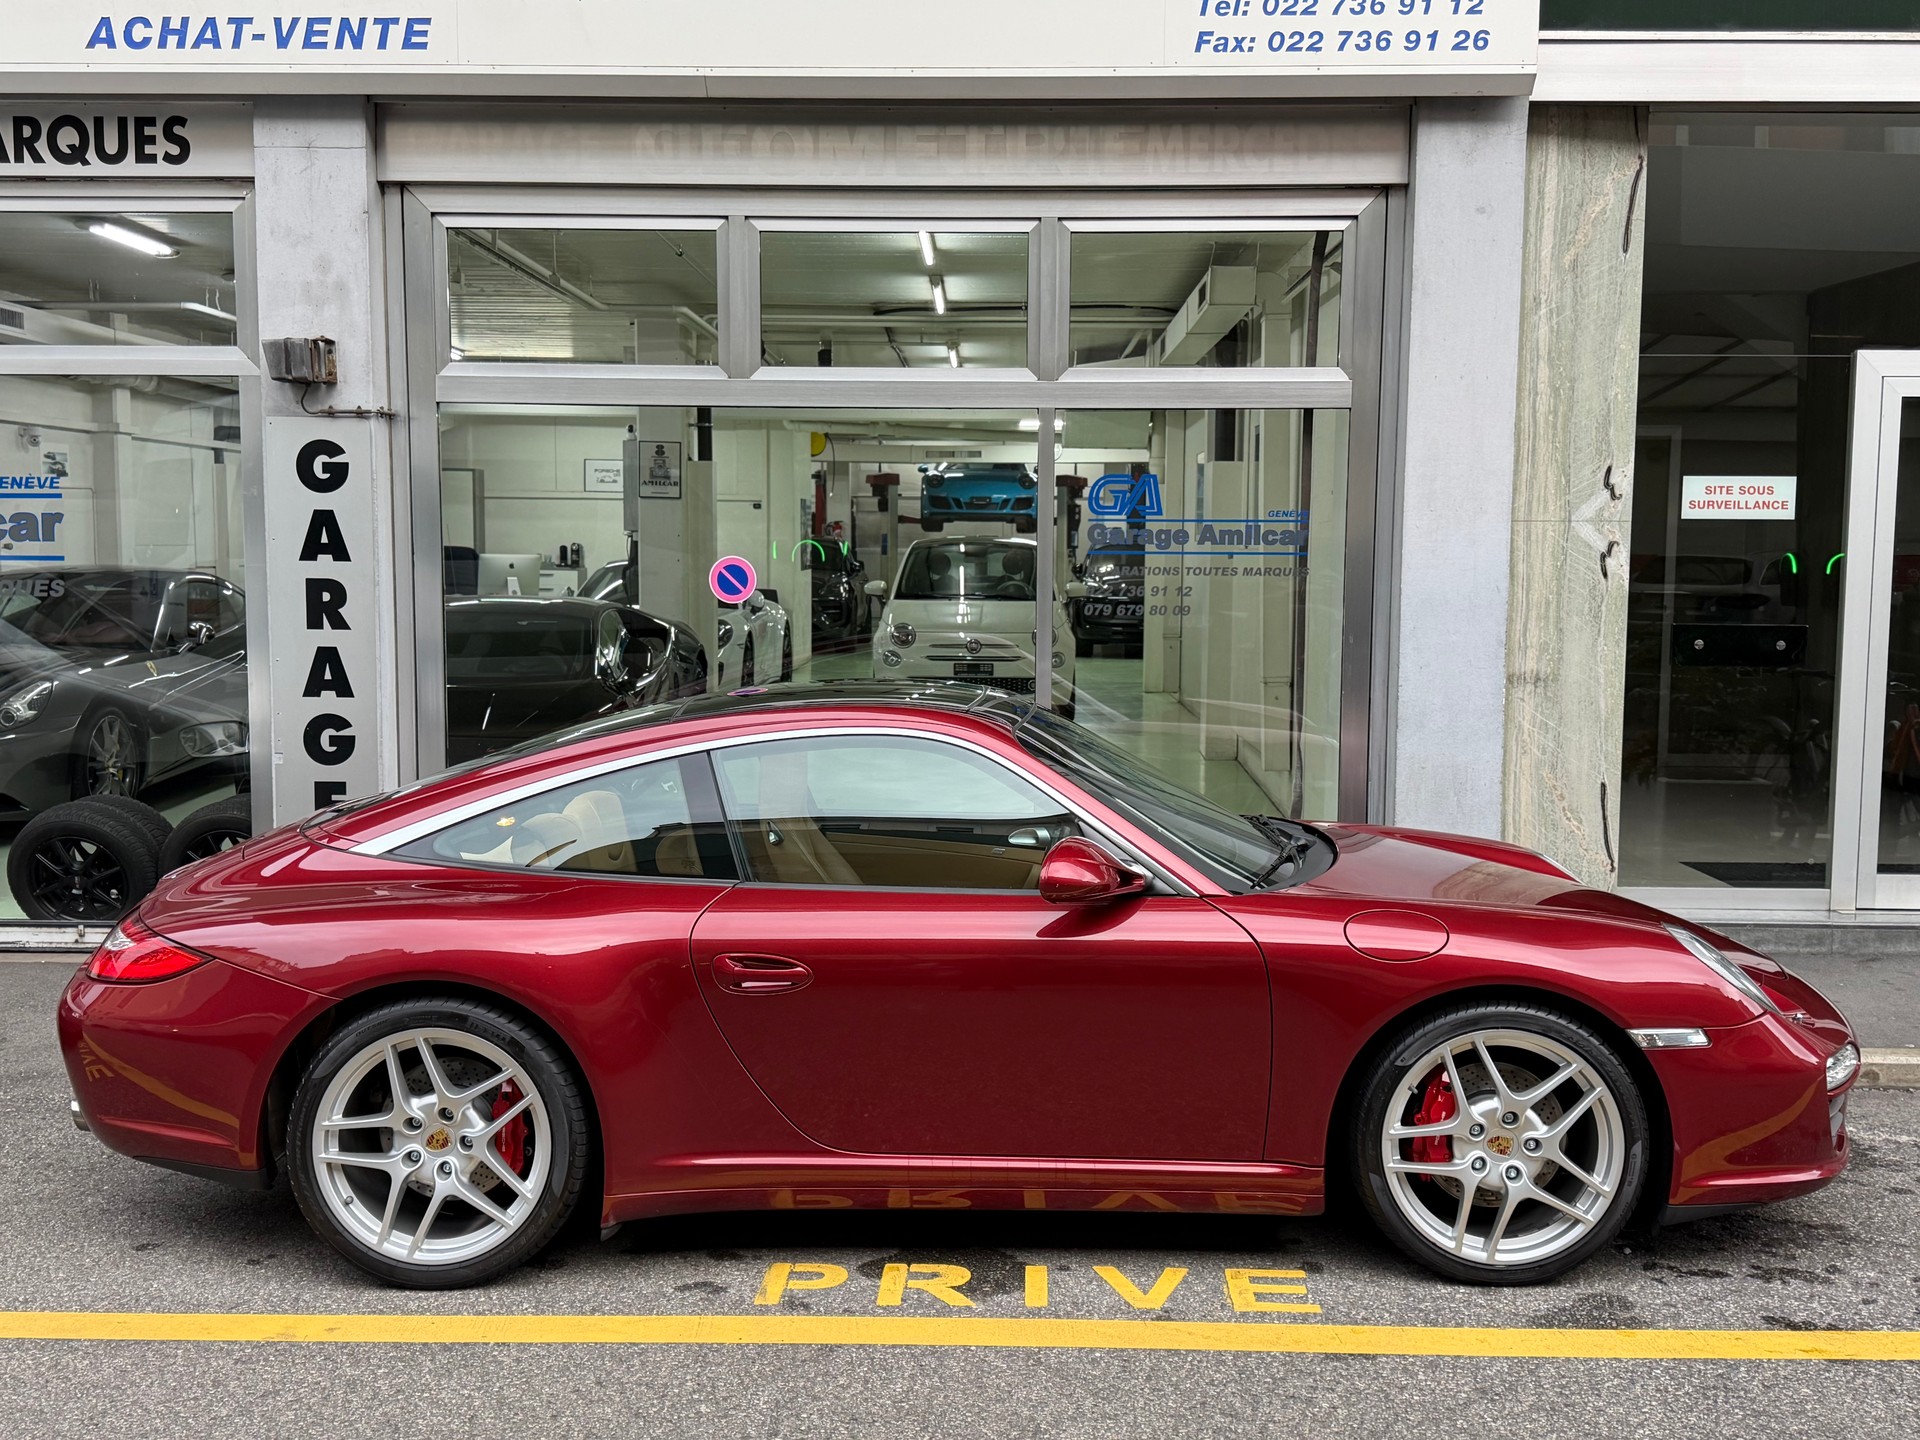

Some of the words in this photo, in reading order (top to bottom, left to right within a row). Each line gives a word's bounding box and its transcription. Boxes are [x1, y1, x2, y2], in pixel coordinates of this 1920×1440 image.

[1262, 0, 1318, 16] 022
[1332, 0, 1386, 16] 736
[1397, 0, 1432, 16] 91
[1451, 0, 1484, 16] 12
[84, 16, 432, 50] ACHAT-VENTE
[1194, 31, 1256, 53] Fax:
[1267, 31, 1324, 53] 022
[1337, 30, 1393, 52] 736
[1403, 30, 1439, 52] 91
[1451, 30, 1491, 52] 26
[0, 114, 191, 167] RQUES
[1088, 474, 1163, 516] GA
[1704, 485, 1734, 495] SITE
[1738, 485, 1774, 495] SOUS
[1688, 500, 1789, 510] SURVEILLANCE
[0, 512, 64, 542] ar
[1088, 524, 1189, 550] Garage
[1197, 524, 1309, 546] Amilcar
[1185, 566, 1238, 576] TOUTES
[1242, 567, 1310, 577] MARQUES
[1150, 586, 1168, 597] 91
[1175, 586, 1193, 597] 12
[1084, 604, 1112, 616] 079
[1116, 604, 1144, 616] 679
[1149, 605, 1167, 616] 80
[1172, 605, 1191, 616] 09
[753, 1262, 1322, 1313] PRIVE
